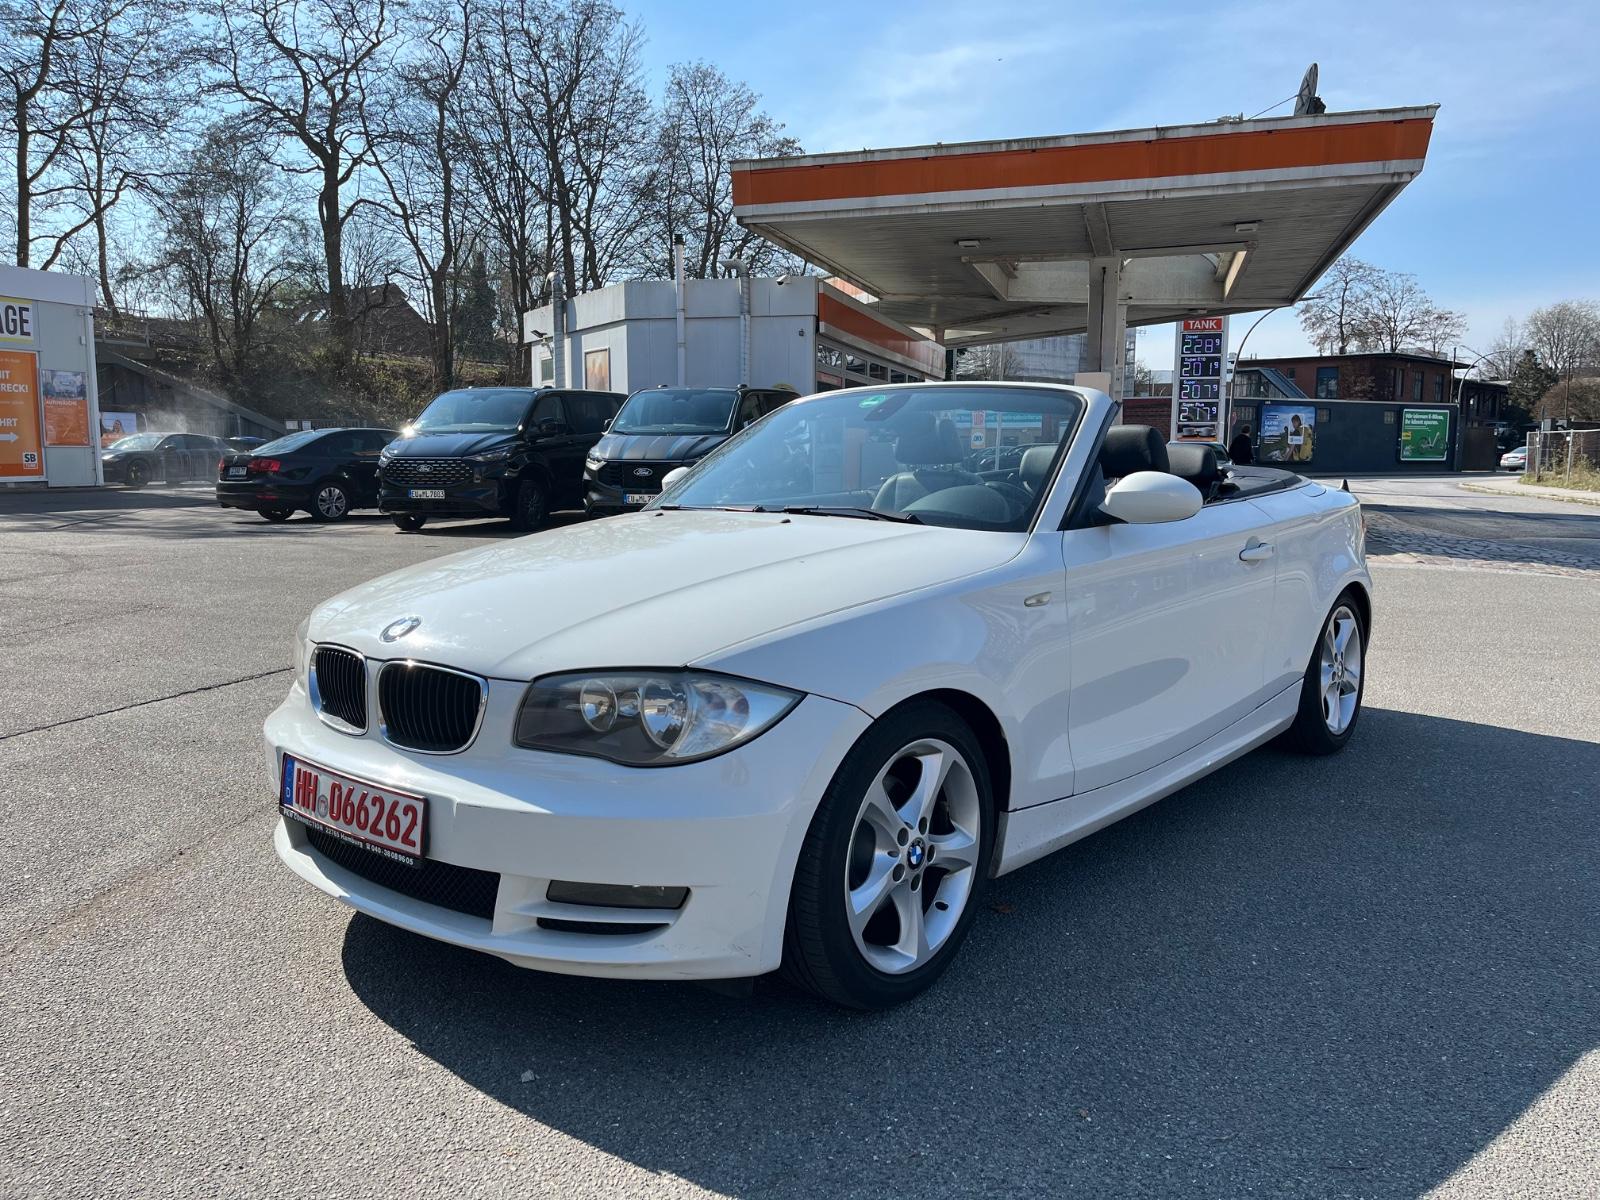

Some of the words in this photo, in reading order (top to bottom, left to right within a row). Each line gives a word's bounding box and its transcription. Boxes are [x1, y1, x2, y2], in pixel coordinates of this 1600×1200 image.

[1188, 320, 1216, 329] TANK
[24, 453, 37, 463] SB
[296, 768, 318, 812] HH
[329, 781, 418, 847] 066262
